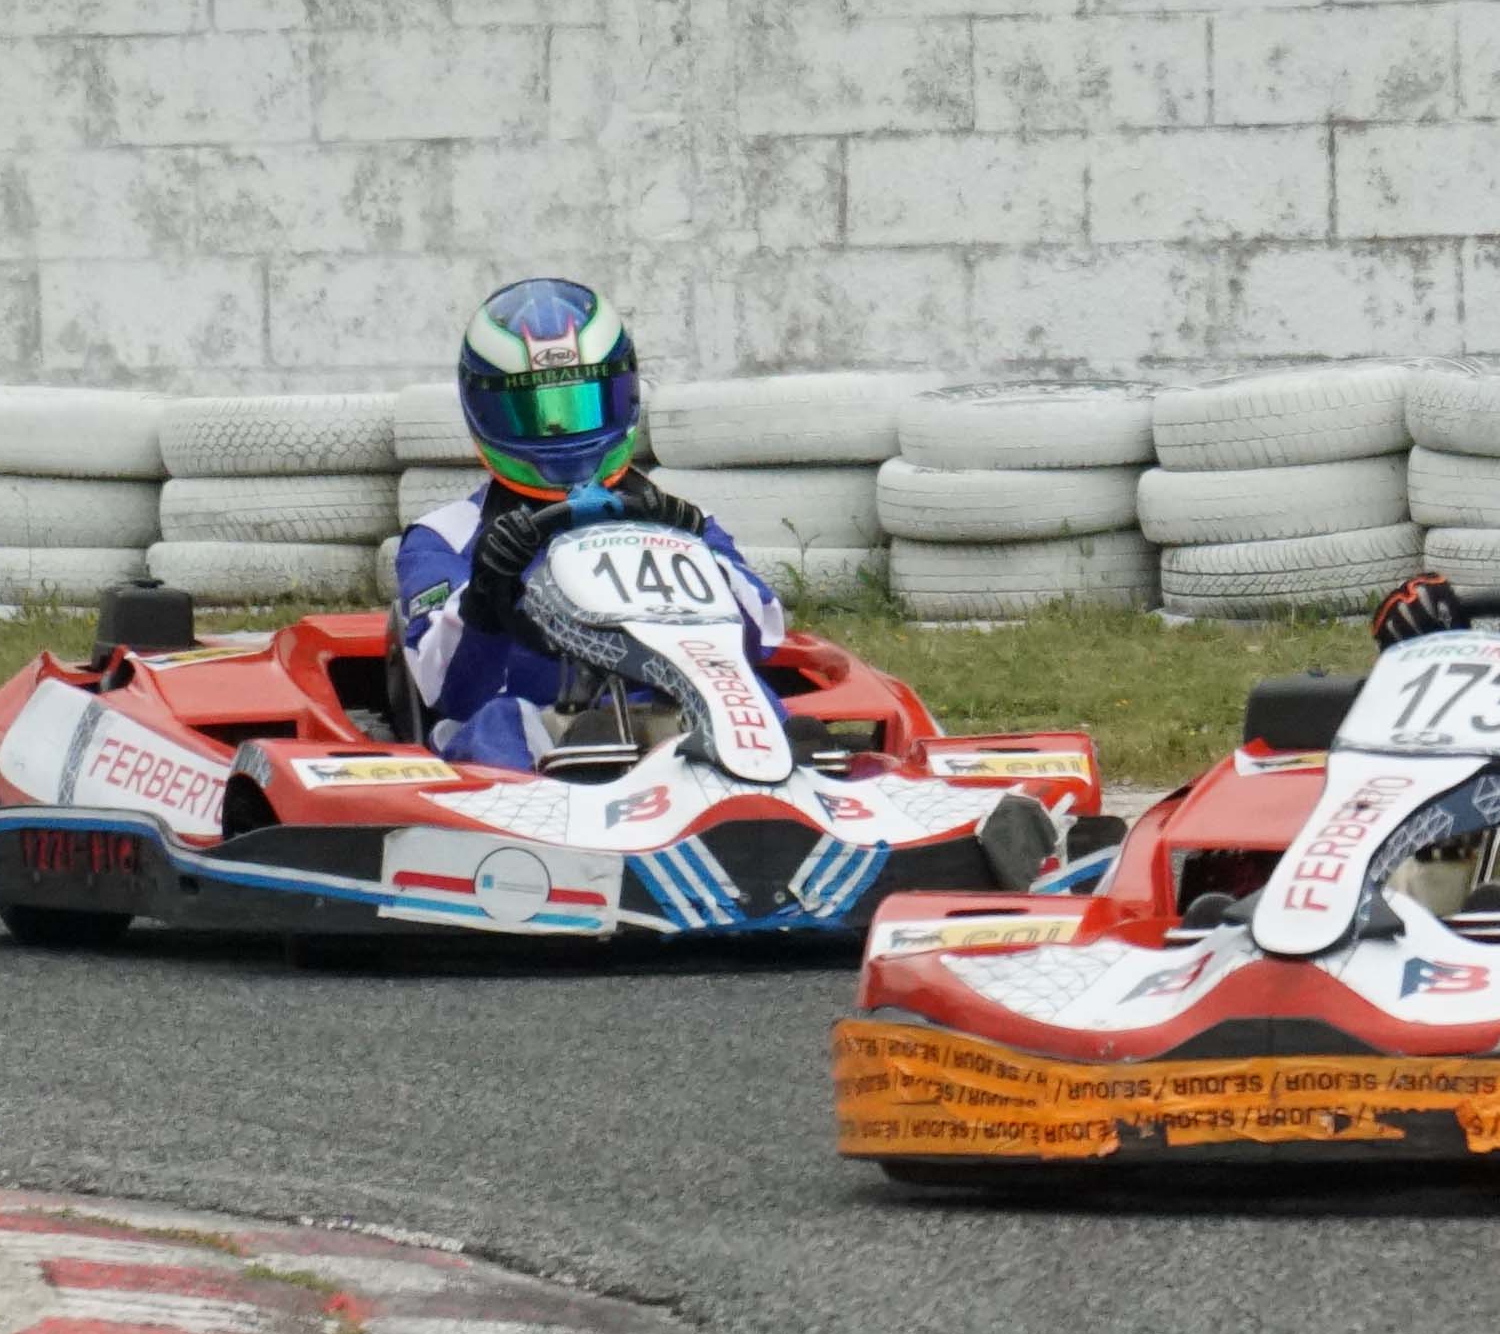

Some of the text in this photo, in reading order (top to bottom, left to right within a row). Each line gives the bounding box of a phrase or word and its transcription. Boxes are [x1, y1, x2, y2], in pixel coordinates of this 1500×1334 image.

[506, 364, 610, 387] HERBALIFE
[578, 533, 693, 552] EUROINDY
[592, 549, 715, 604] 140
[678, 640, 772, 751] FERBERTO
[1284, 776, 1414, 911] FERBERTO
